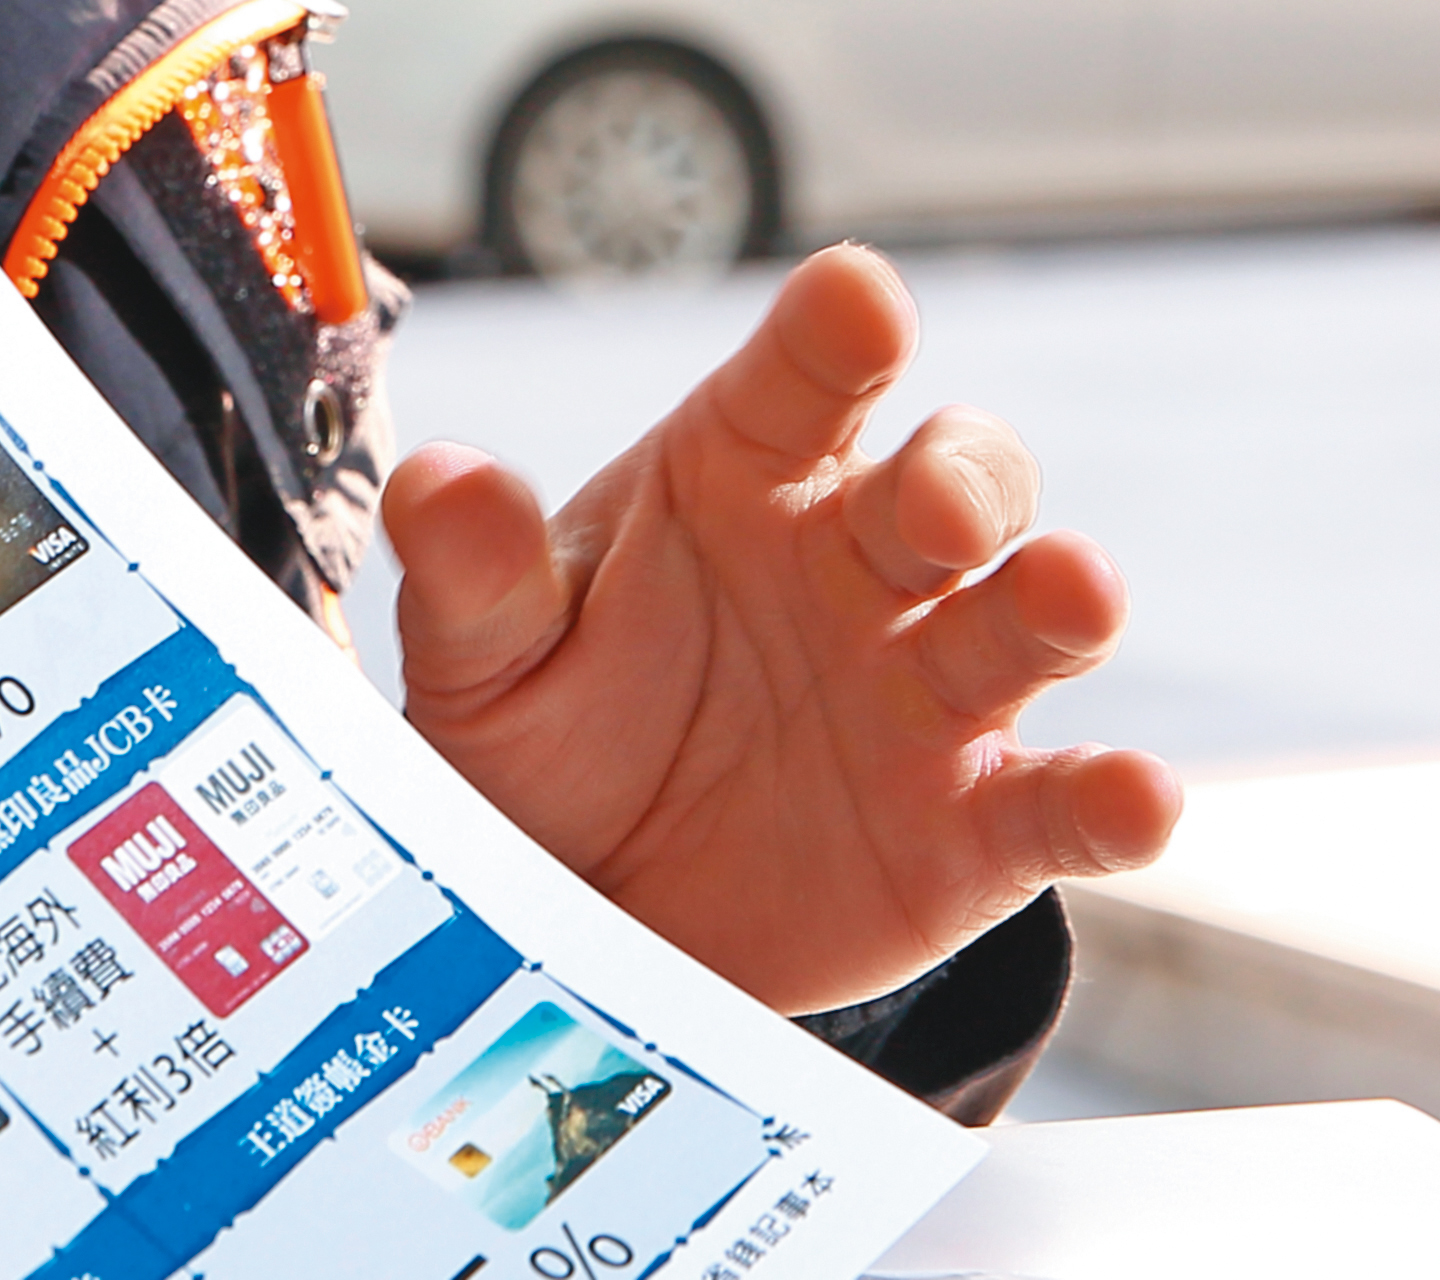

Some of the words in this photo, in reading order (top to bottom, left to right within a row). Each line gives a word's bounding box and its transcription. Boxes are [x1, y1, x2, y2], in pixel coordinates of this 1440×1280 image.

[27, 526, 78, 567] VISA
[194, 741, 278, 817] MUJI
[99, 814, 188, 893] MUJI
[76, 1019, 237, 1162] 紅利3倍
[616, 1075, 665, 1117] VISA
